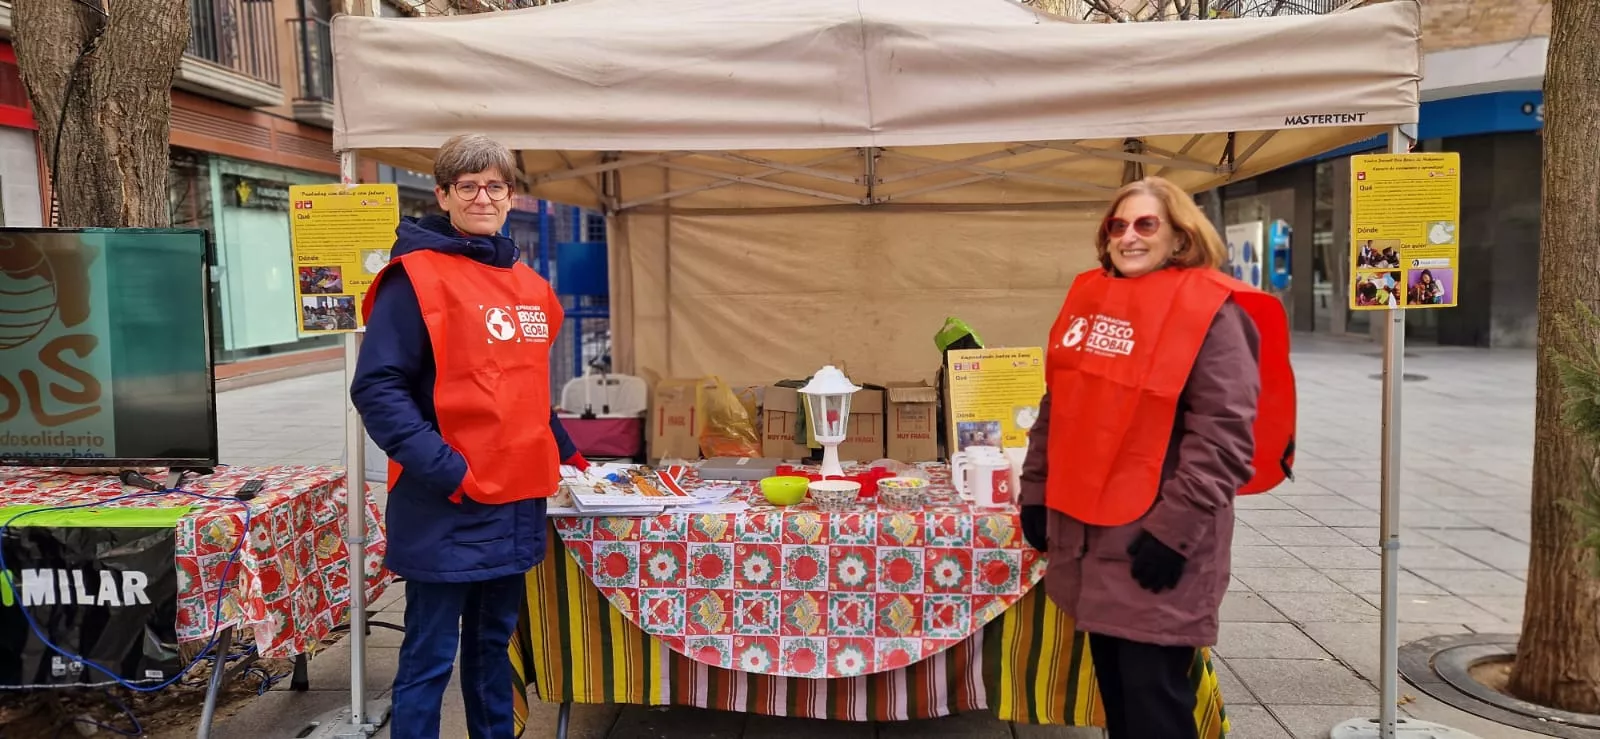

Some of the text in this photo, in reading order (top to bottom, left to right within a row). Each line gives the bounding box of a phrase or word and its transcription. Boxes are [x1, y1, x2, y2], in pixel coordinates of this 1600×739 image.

[1285, 113, 1365, 126] MASTERTENT
[517, 311, 547, 322] BOSCO
[21, 568, 152, 607] MILAR
